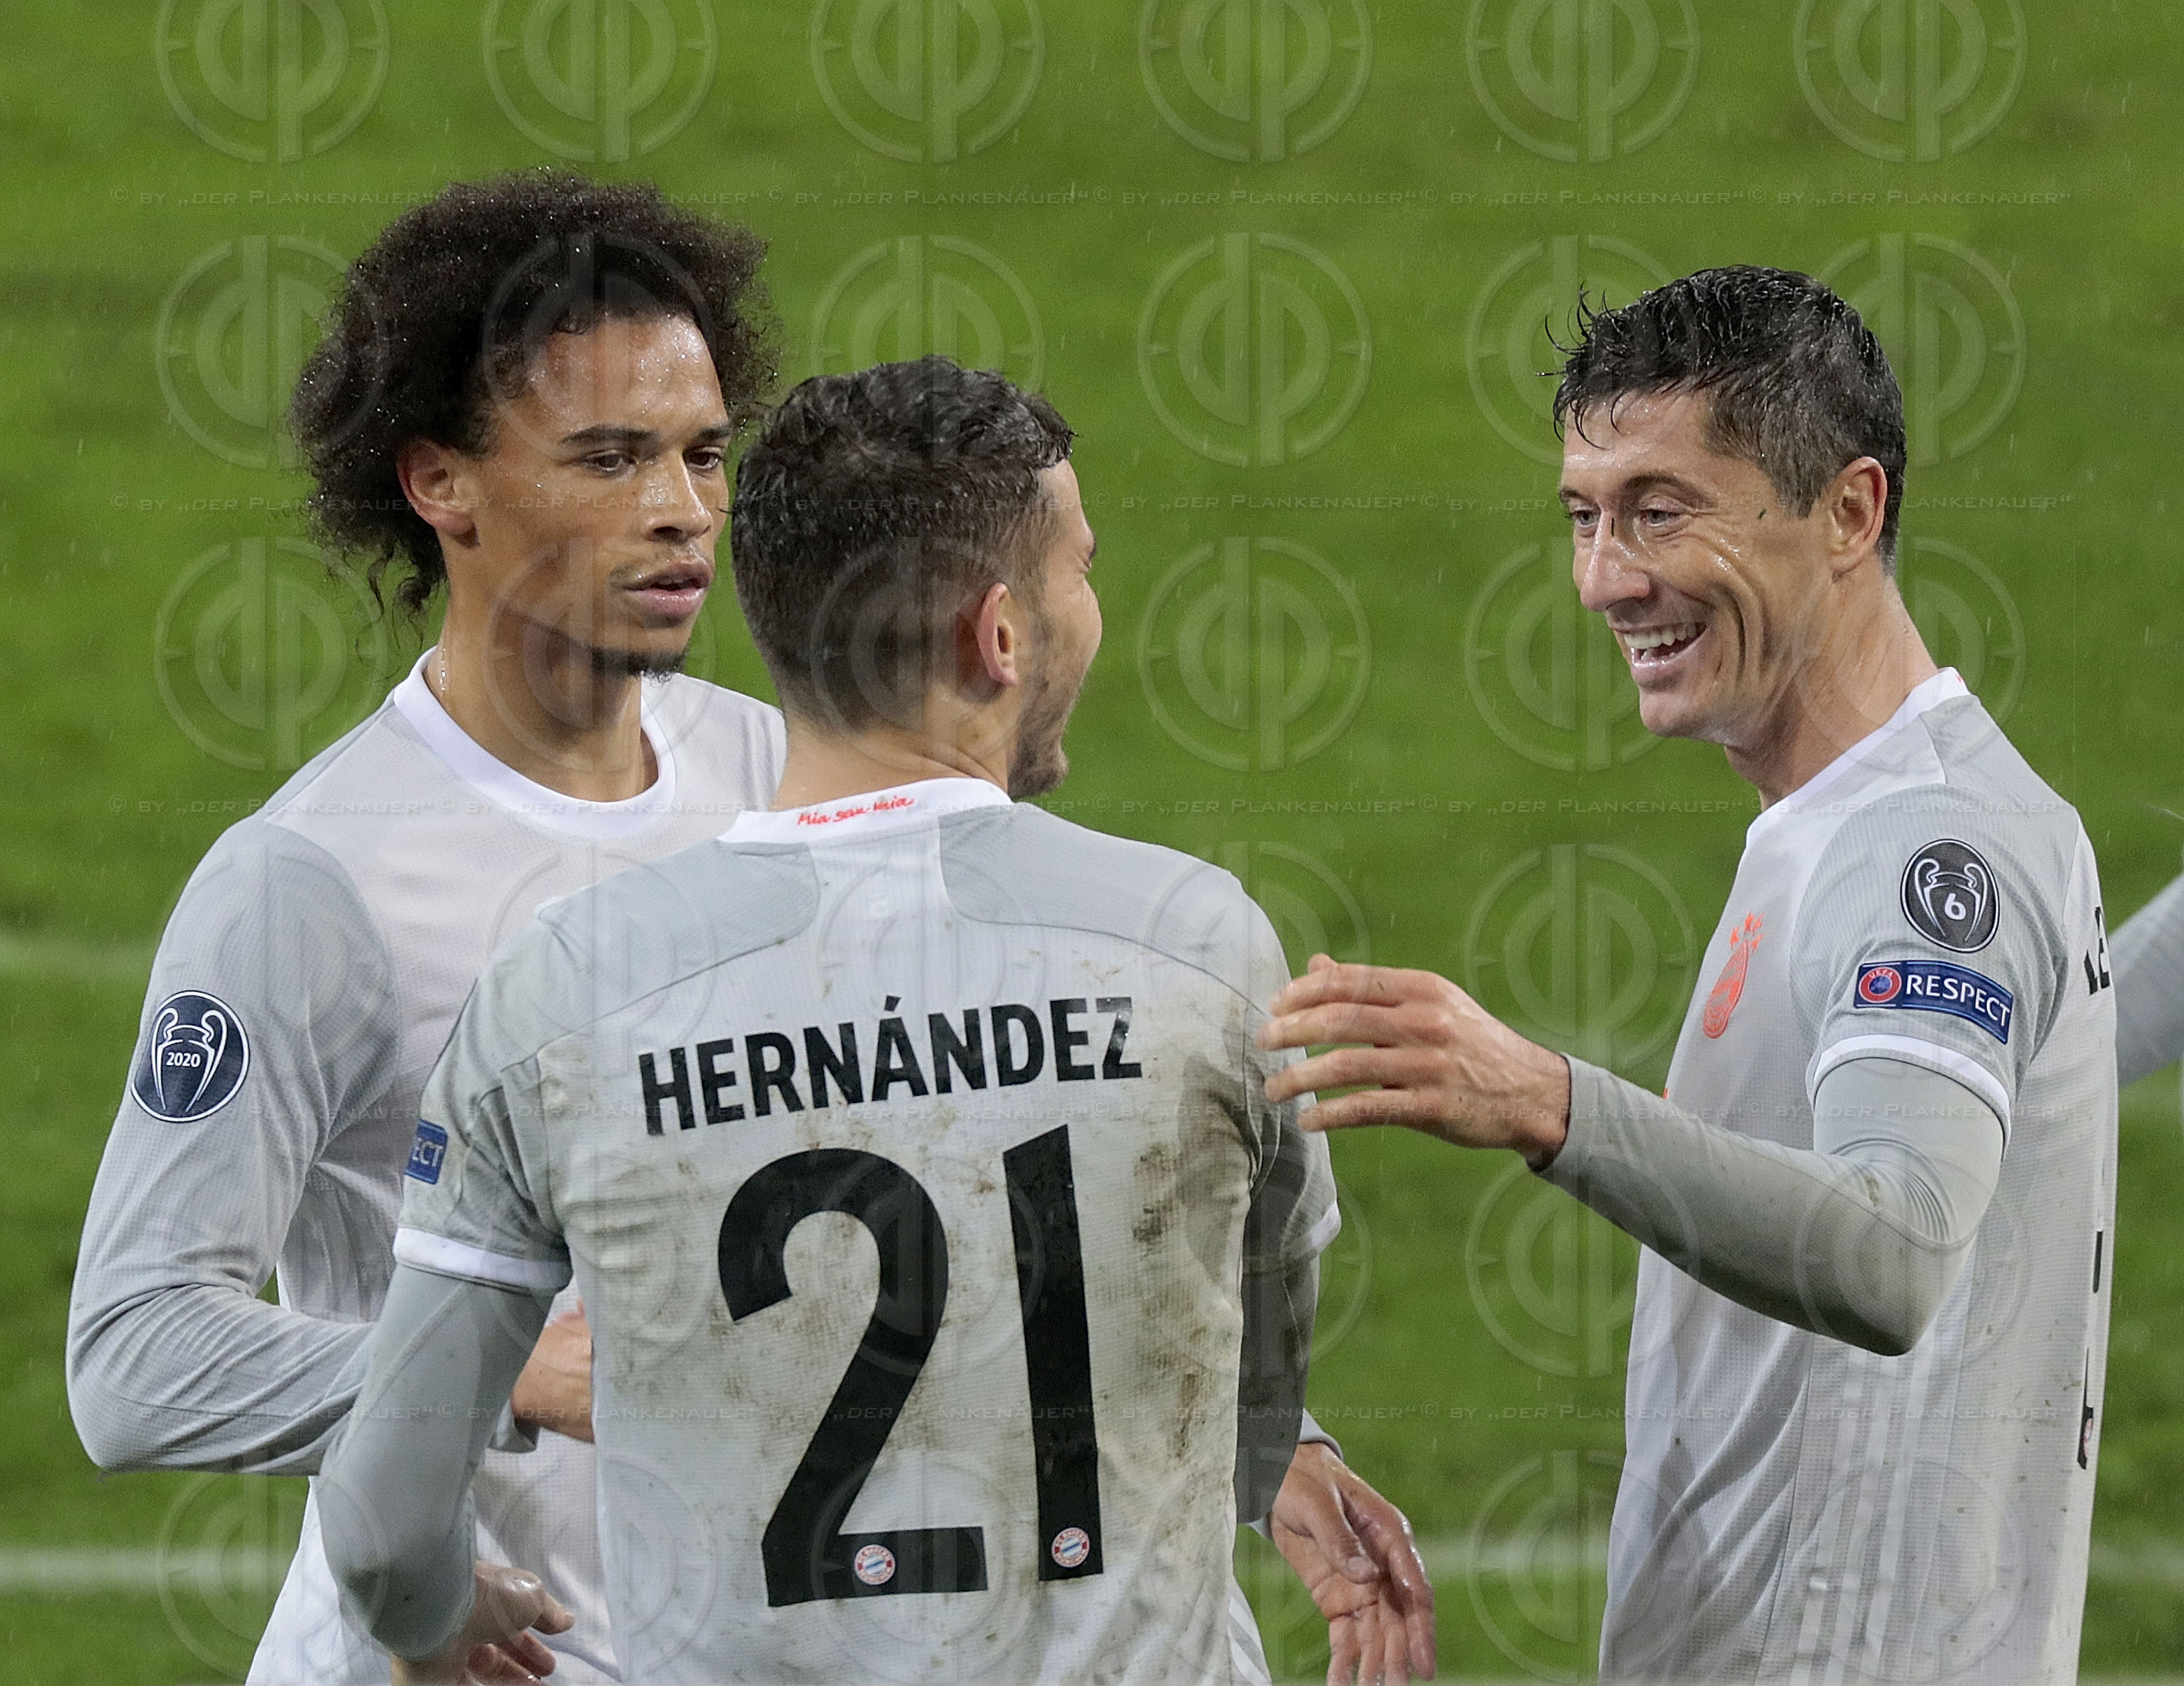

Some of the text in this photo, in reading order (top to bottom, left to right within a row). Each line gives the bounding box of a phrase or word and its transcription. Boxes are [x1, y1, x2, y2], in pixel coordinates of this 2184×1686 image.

[1944, 892, 1967, 921] 6
[1868, 966, 1894, 979] UEFA
[1905, 974, 2011, 1027] RESPECT
[165, 1051, 202, 1068] 2020
[638, 995, 1142, 1137] HERNÁNDEZ
[718, 1123, 1105, 1608] 21
